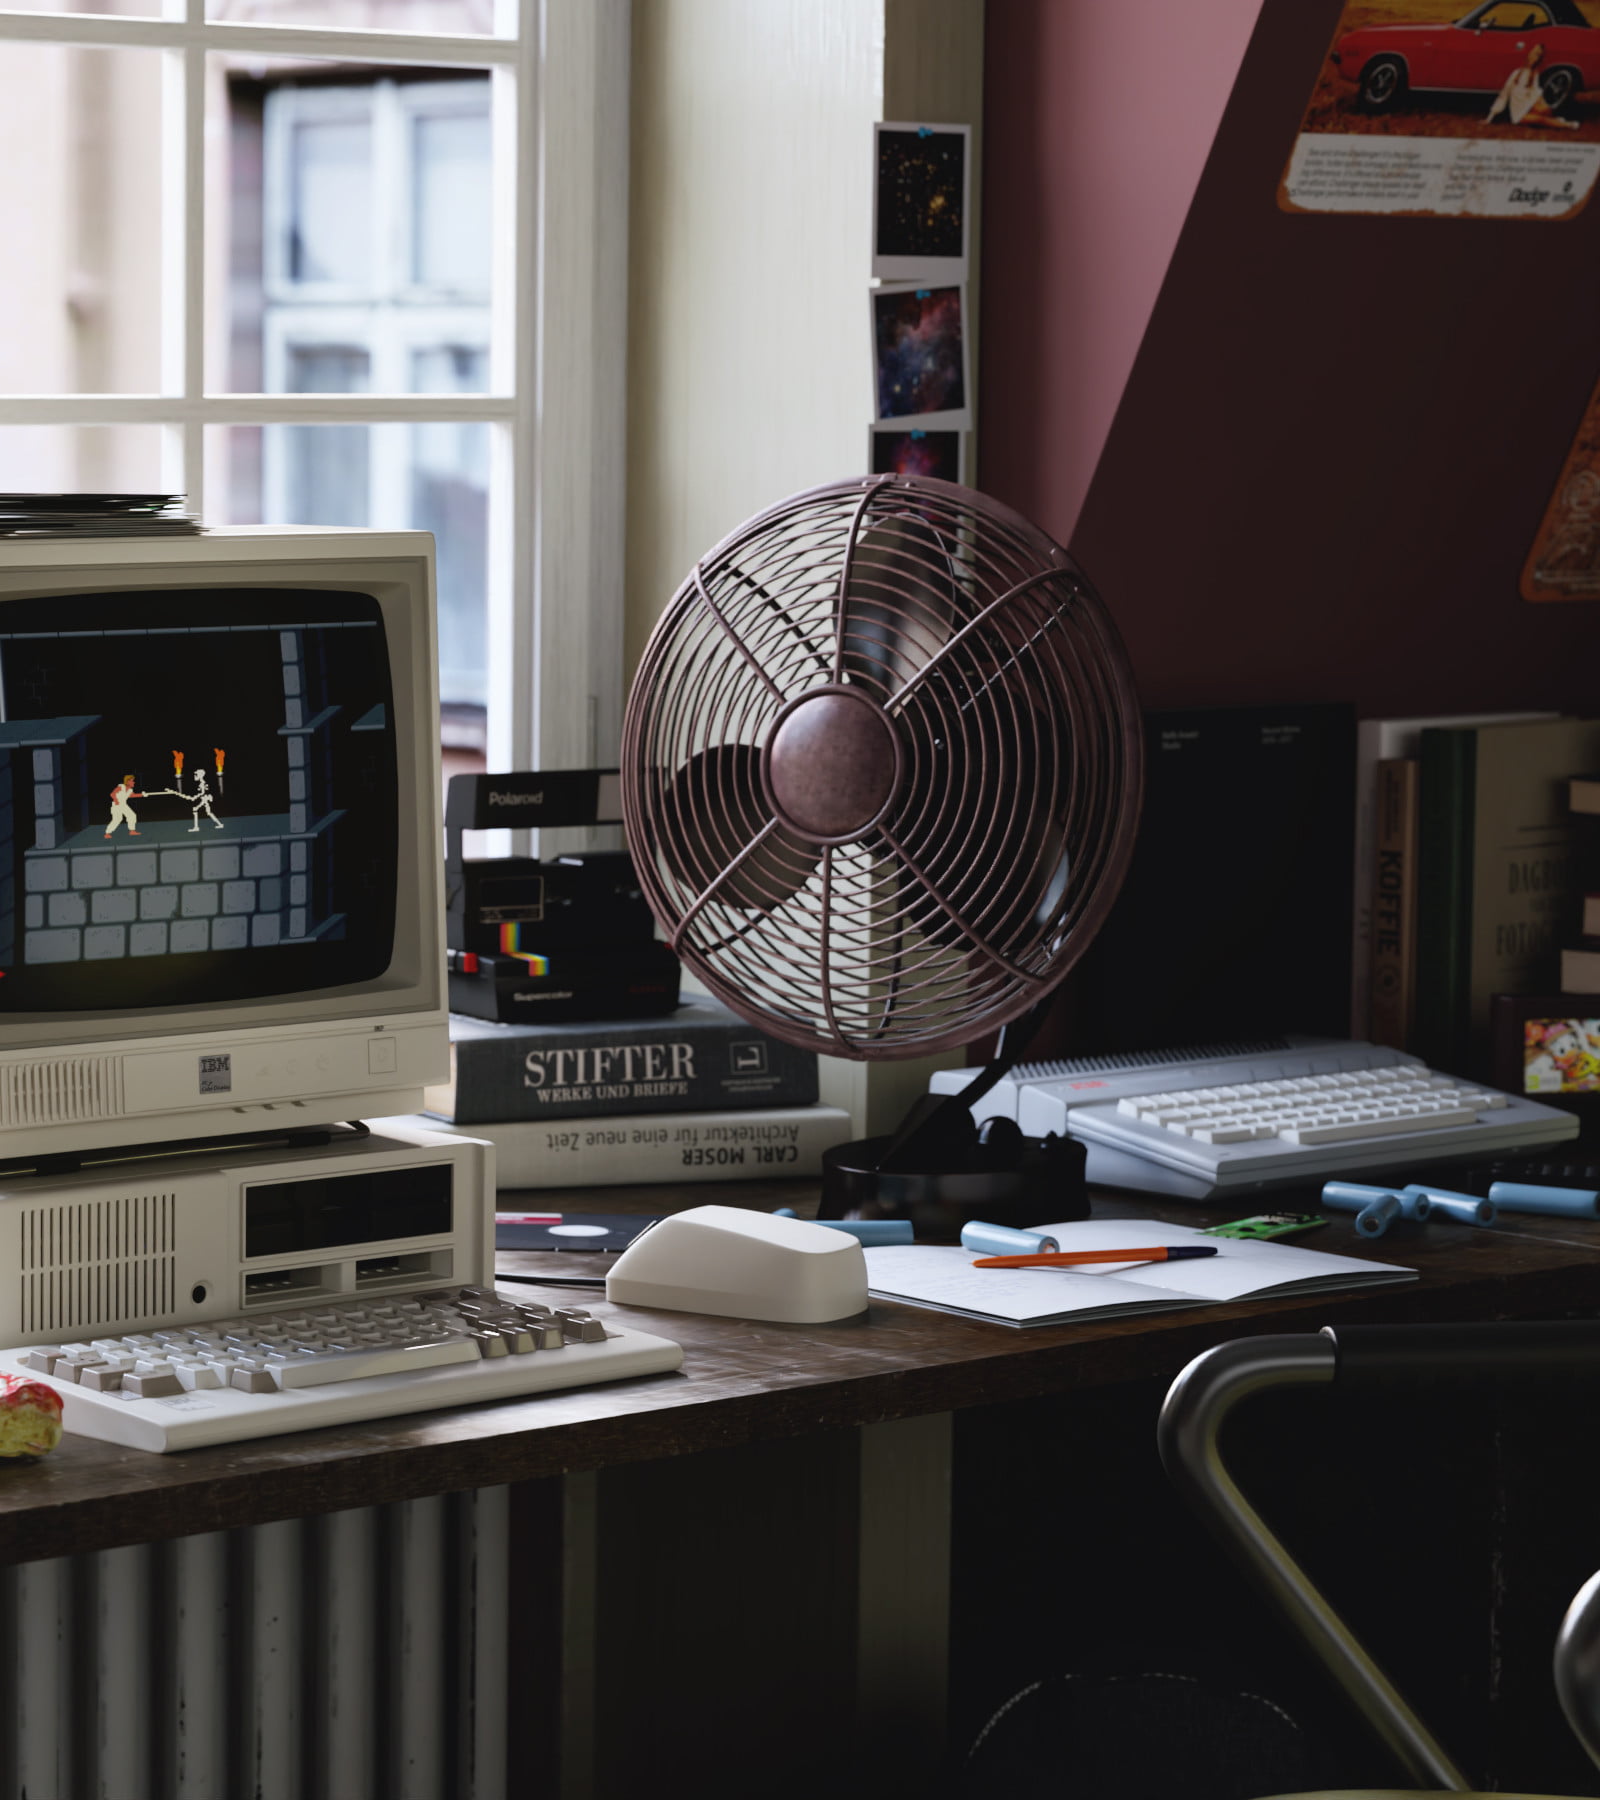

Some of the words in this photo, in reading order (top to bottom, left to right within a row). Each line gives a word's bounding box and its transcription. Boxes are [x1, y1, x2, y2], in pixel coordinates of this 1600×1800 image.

[1508, 187, 1550, 207] Dodge
[488, 790, 544, 806] Polaroid
[1376, 850, 1403, 956] KOFFIE
[513, 990, 573, 1002] Supercolor
[201, 1057, 229, 1072] IBM
[523, 1043, 698, 1088] STIFTER
[536, 1086, 592, 1103] WERKE
[595, 1085, 630, 1099] UND
[633, 1081, 689, 1097] BRIEFE
[546, 1133, 580, 1152] Zeit
[586, 1131, 627, 1145] neue
[632, 1129, 668, 1147] eine
[673, 1128, 698, 1147] für
[704, 1124, 799, 1144] Architektur
[682, 1147, 744, 1166] MOSER
[753, 1145, 798, 1163] CARL
